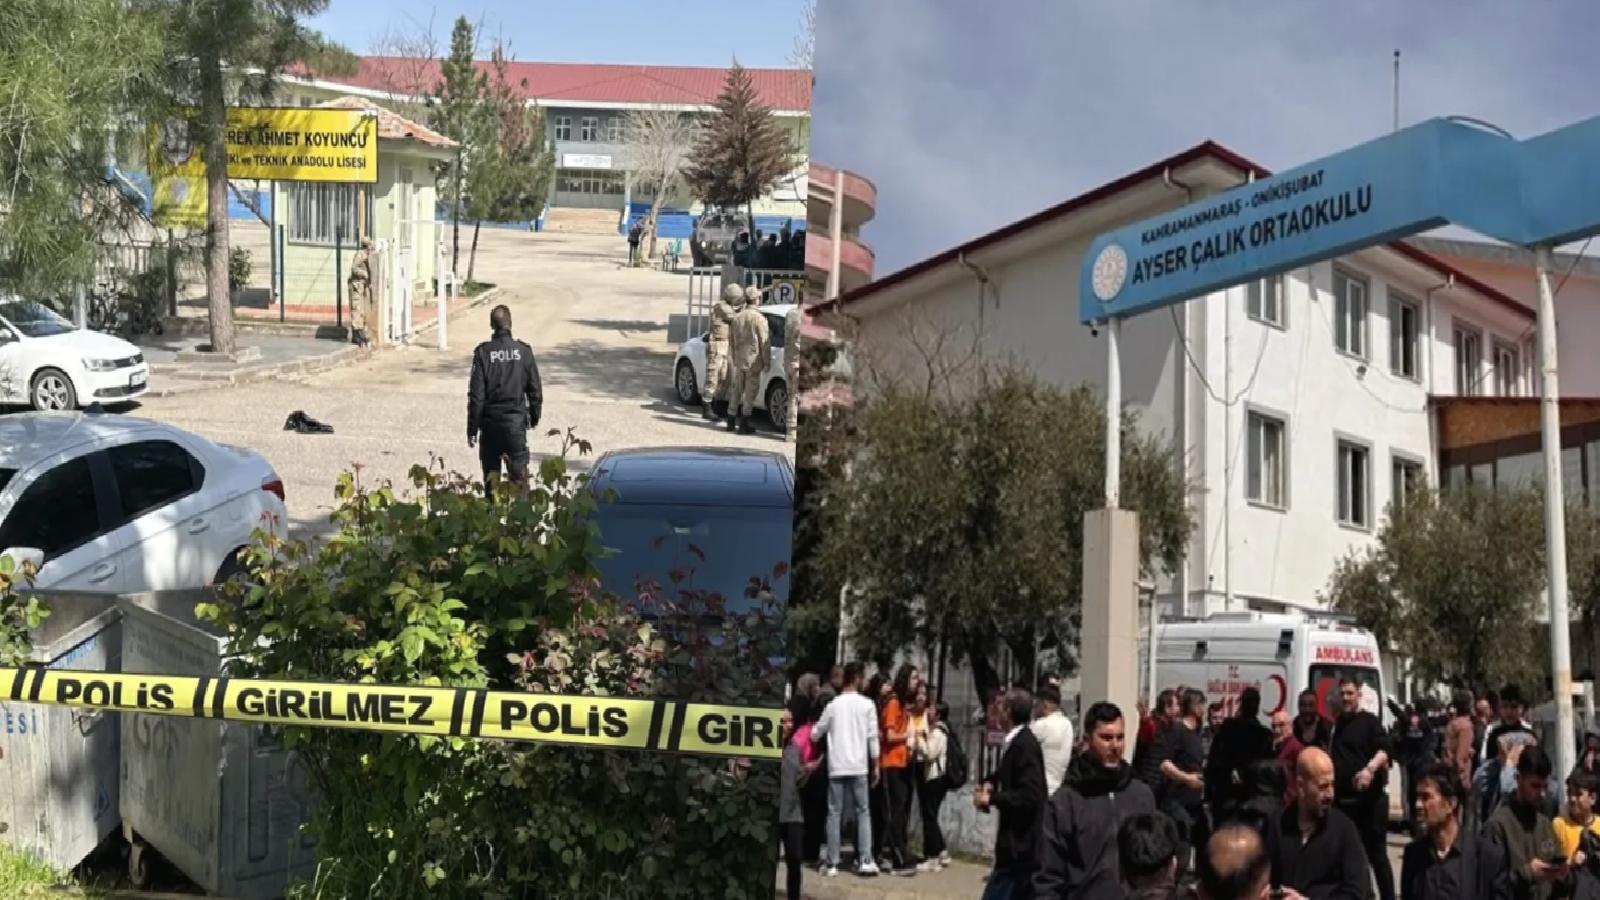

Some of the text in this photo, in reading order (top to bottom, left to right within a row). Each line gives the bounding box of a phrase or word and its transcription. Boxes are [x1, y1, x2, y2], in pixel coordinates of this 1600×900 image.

[255, 154, 288, 167] TEKNİK
[291, 155, 334, 168] ANADOLU
[337, 155, 366, 169] LİSESİ
[258, 129, 299, 147] AHMET
[305, 131, 367, 148] KOYUNCU
[1131, 183, 1372, 285] AYSER ÇALIK ORTAOKULU
[1141, 198, 1243, 246] KAHRAMANMARAŞ
[236, 687, 435, 726] GİRİLMEZ
[500, 700, 629, 738] POLİS
